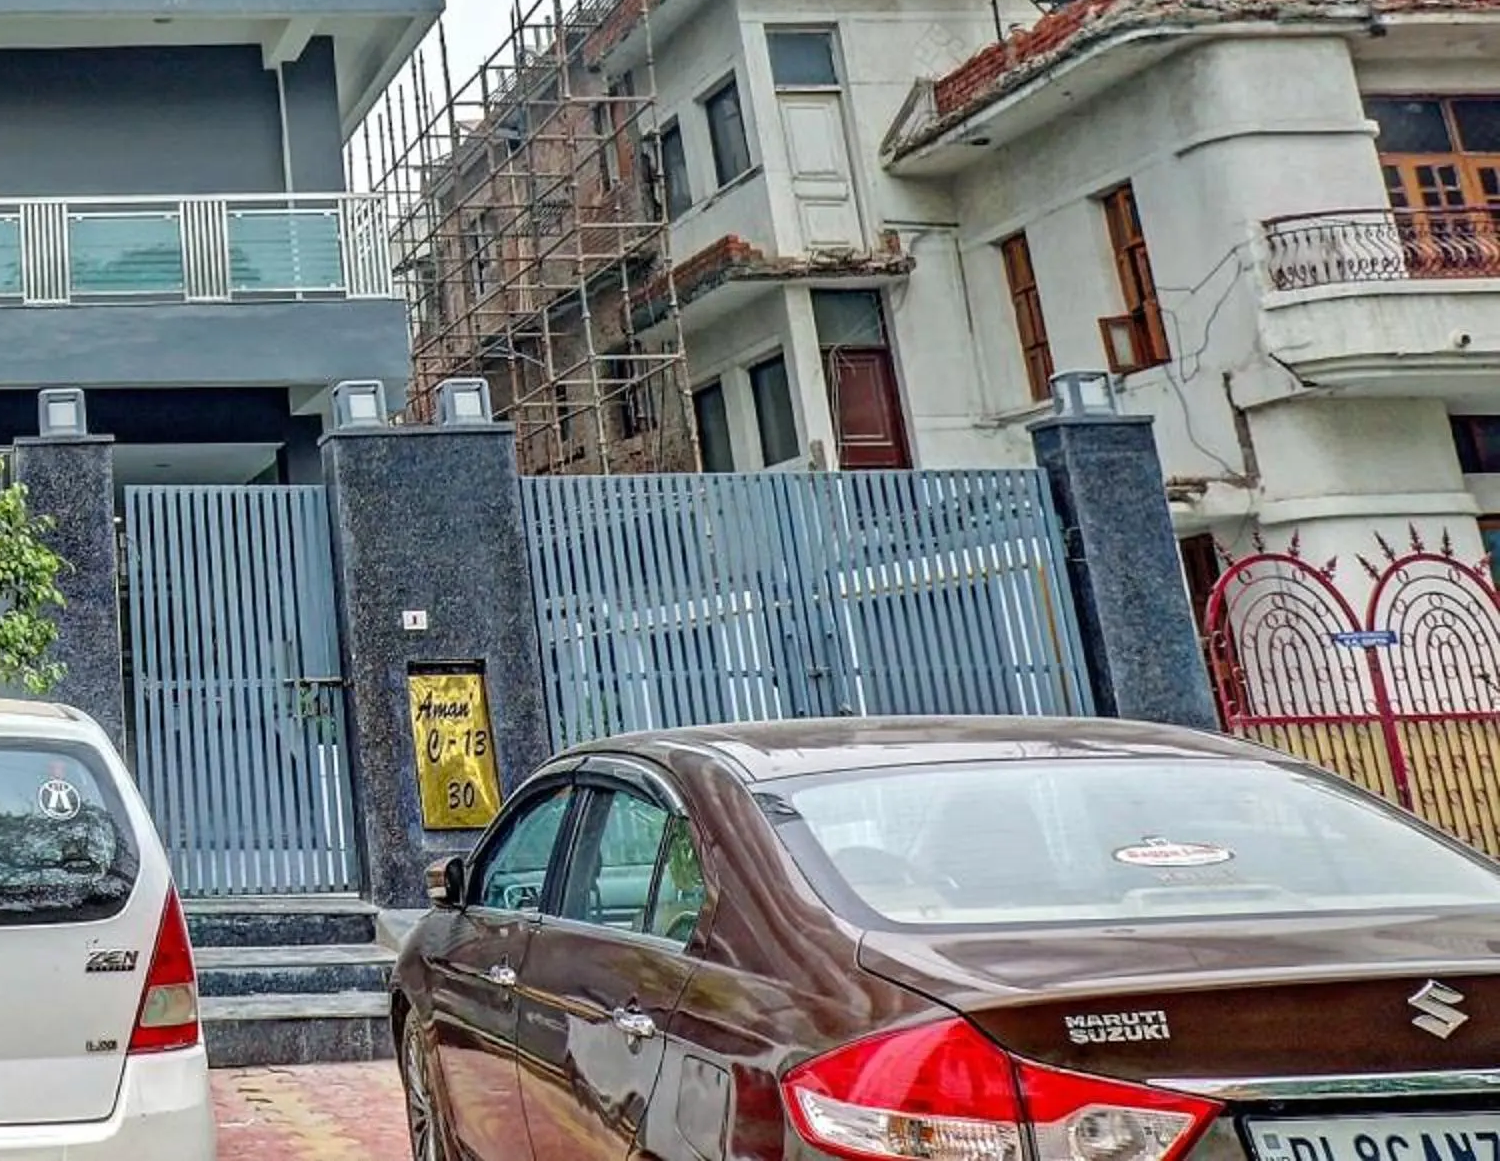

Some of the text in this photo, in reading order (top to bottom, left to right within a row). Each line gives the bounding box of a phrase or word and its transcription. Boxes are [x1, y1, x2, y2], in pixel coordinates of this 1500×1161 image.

[449, 782, 475, 809] 30
[86, 950, 139, 967] ZEN
[1064, 1010, 1167, 1029] MARUTI
[1069, 1024, 1171, 1044] SUZUKI
